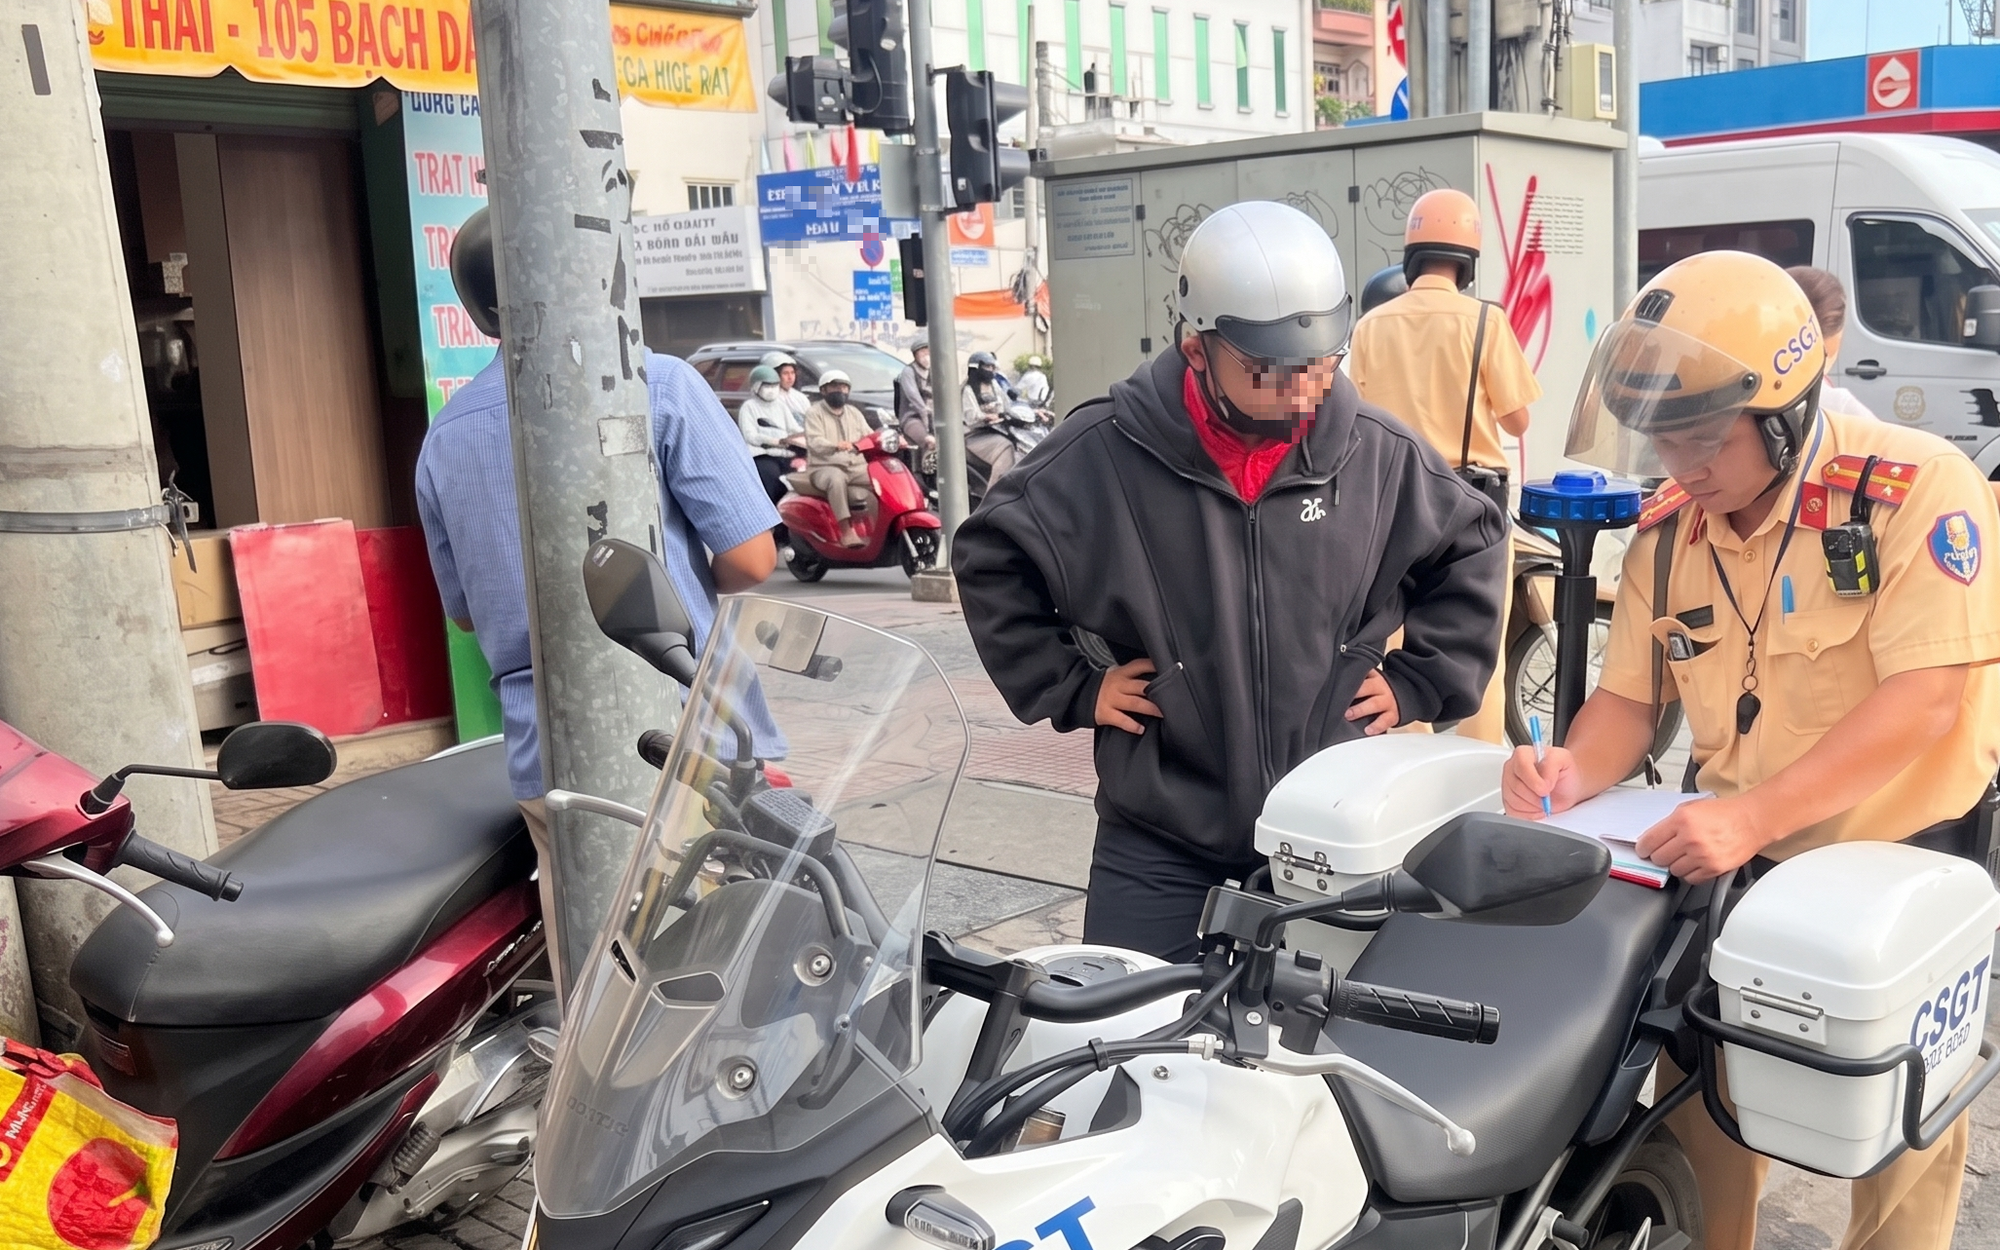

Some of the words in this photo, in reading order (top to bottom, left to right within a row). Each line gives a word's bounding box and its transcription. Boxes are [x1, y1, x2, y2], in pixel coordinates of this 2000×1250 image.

[255, 0, 319, 63] 105
[330, 0, 429, 79] BẠCH
[1773, 314, 1819, 375] CSGT
[1909, 953, 1990, 1053] CSGT
